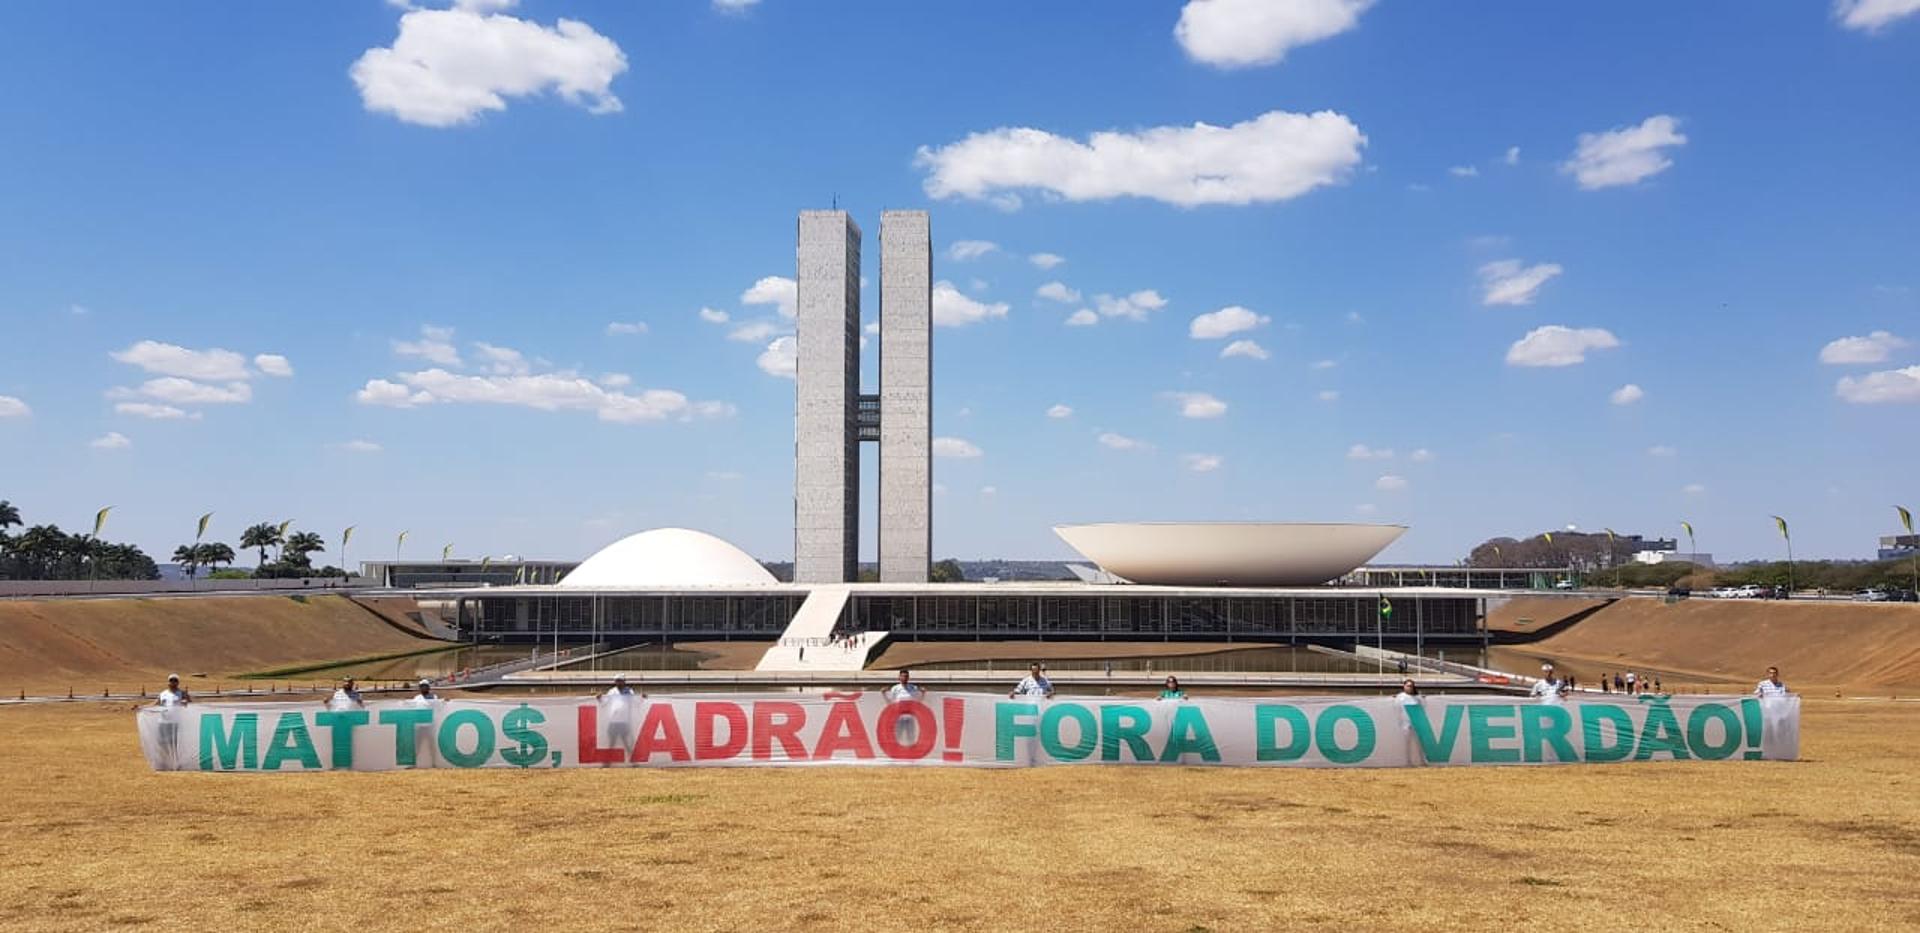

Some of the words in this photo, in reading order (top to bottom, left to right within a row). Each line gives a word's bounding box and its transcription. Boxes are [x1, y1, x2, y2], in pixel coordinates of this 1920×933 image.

[578, 692, 964, 766] LADRÃO!
[996, 703, 1221, 763] FORA
[1255, 704, 1376, 763] DO
[1404, 694, 1764, 763] VERDÃO!
